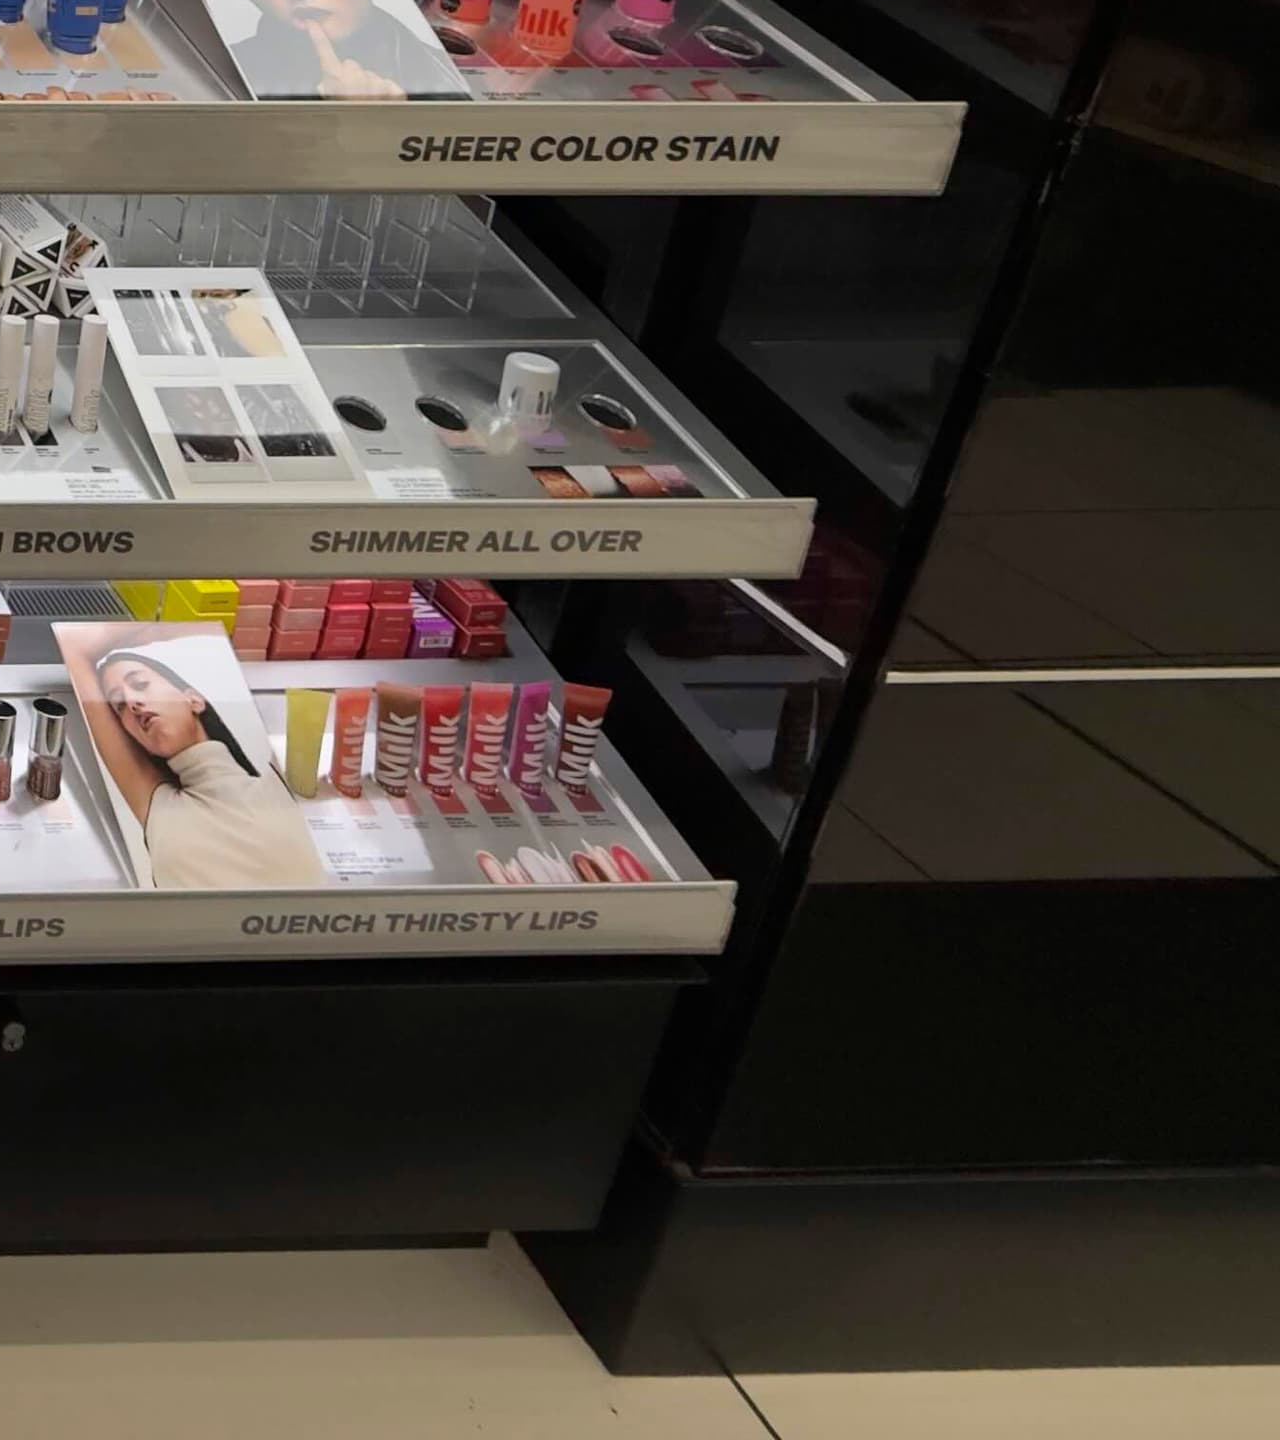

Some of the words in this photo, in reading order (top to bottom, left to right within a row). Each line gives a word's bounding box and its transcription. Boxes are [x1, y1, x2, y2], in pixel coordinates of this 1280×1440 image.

[398, 135, 522, 163] SHEER
[529, 135, 658, 163] COLOR
[664, 135, 781, 163] STAIN
[12, 531, 135, 554] BROWS
[309, 530, 469, 554] SHIMMER
[476, 530, 541, 553] ALL
[549, 530, 643, 553] OVER
[340, 715, 367, 788] Milk
[376, 711, 419, 787] Milk
[427, 715, 461, 787] Milk
[470, 713, 510, 787] Milk
[521, 712, 549, 785] Milk
[557, 713, 605, 787] Milk
[240, 913, 376, 937] QUENCH
[385, 912, 523, 935] THIRSTY
[528, 910, 599, 932] LIPS
